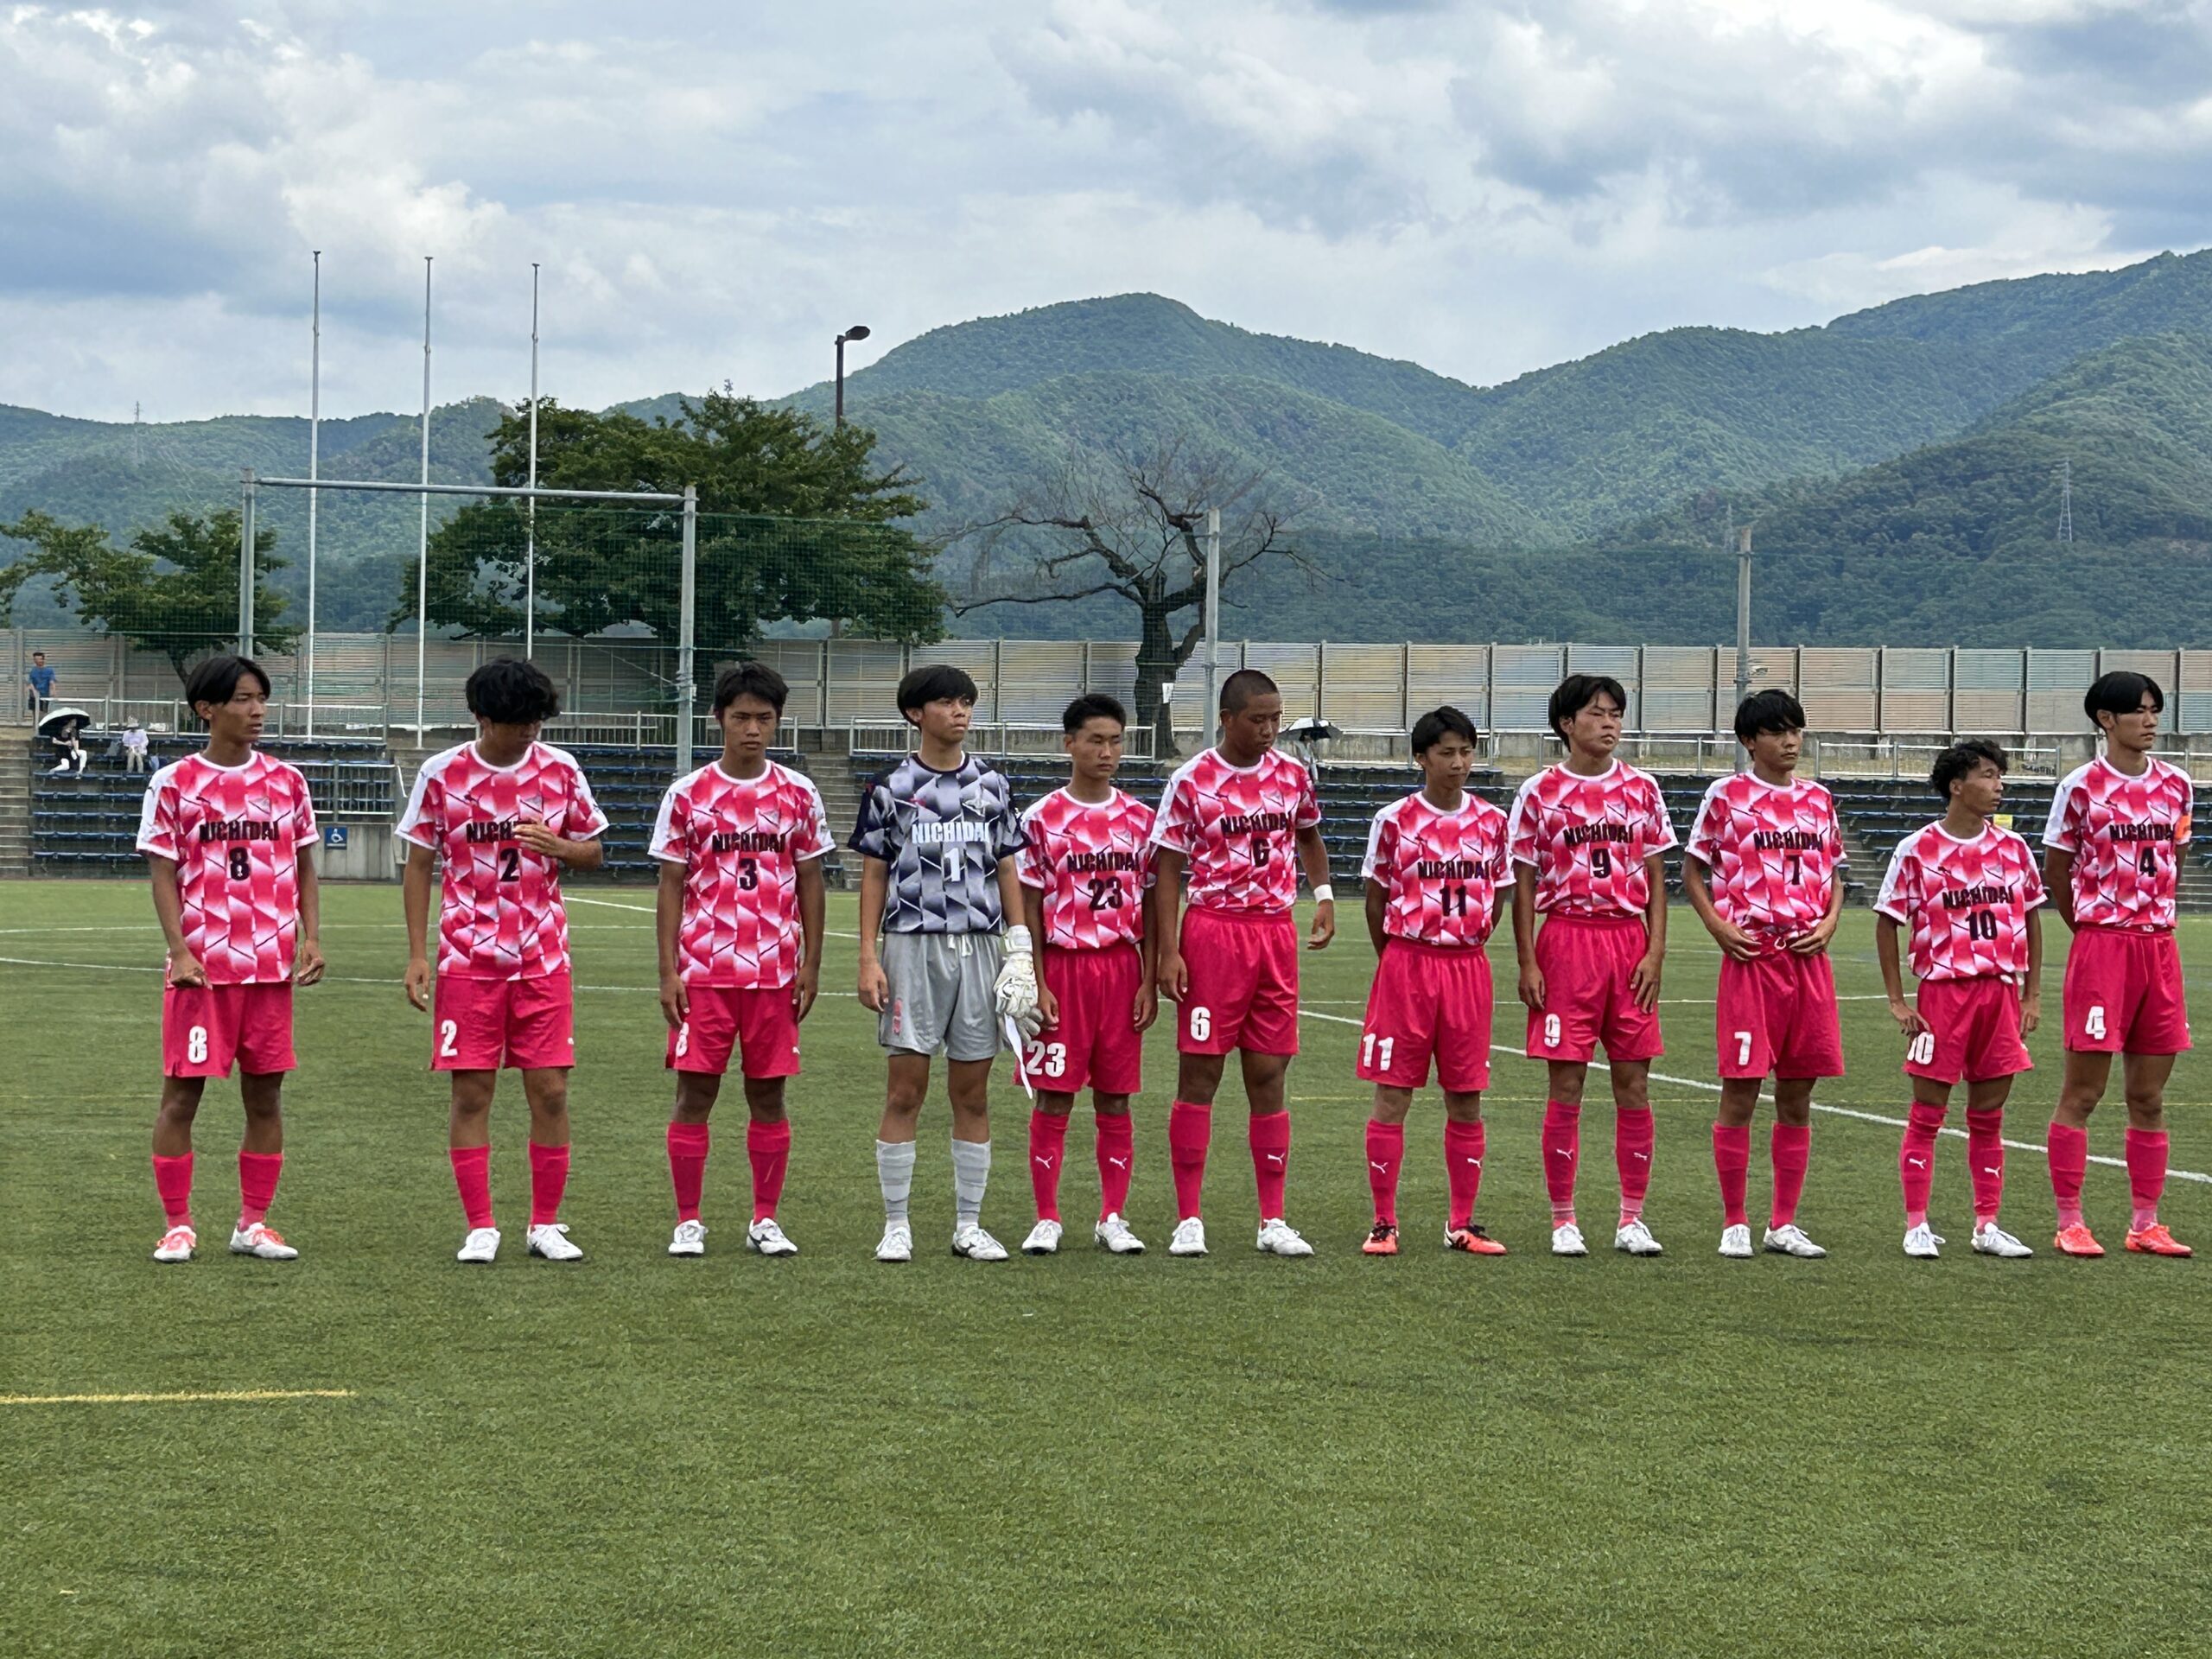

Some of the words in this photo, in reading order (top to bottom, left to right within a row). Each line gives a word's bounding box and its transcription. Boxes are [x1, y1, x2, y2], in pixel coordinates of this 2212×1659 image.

[712, 831, 785, 854] NICHIDAI
[912, 822, 989, 844] NICHIDAI
[1563, 823, 1633, 848] NICHIDAI
[1753, 831, 1824, 853] NICHIDAI
[229, 847, 250, 880] 8
[499, 848, 519, 882] 2
[944, 847, 961, 882] 1
[1067, 852, 1140, 874] NICHIDAI
[1252, 836, 1270, 868] 6
[1592, 849, 1611, 879] 9
[2139, 847, 2158, 877] 4
[739, 858, 758, 891] 3
[1417, 859, 1490, 880] NICHIDAI
[1785, 855, 1800, 886] 7
[1088, 875, 1123, 910] 23
[1440, 884, 1466, 917] 11
[1942, 886, 2014, 910] NICHIDAI
[1965, 909, 1998, 940] 10
[441, 1019, 458, 1057] 2
[1191, 1006, 1211, 1041] 6
[1544, 1013, 1560, 1048] 9
[2084, 1005, 2107, 1040] 4
[188, 1025, 207, 1064] 8
[1026, 1039, 1067, 1077] 23
[1363, 1033, 1394, 1071] 11
[1734, 1031, 1752, 1065] 7
